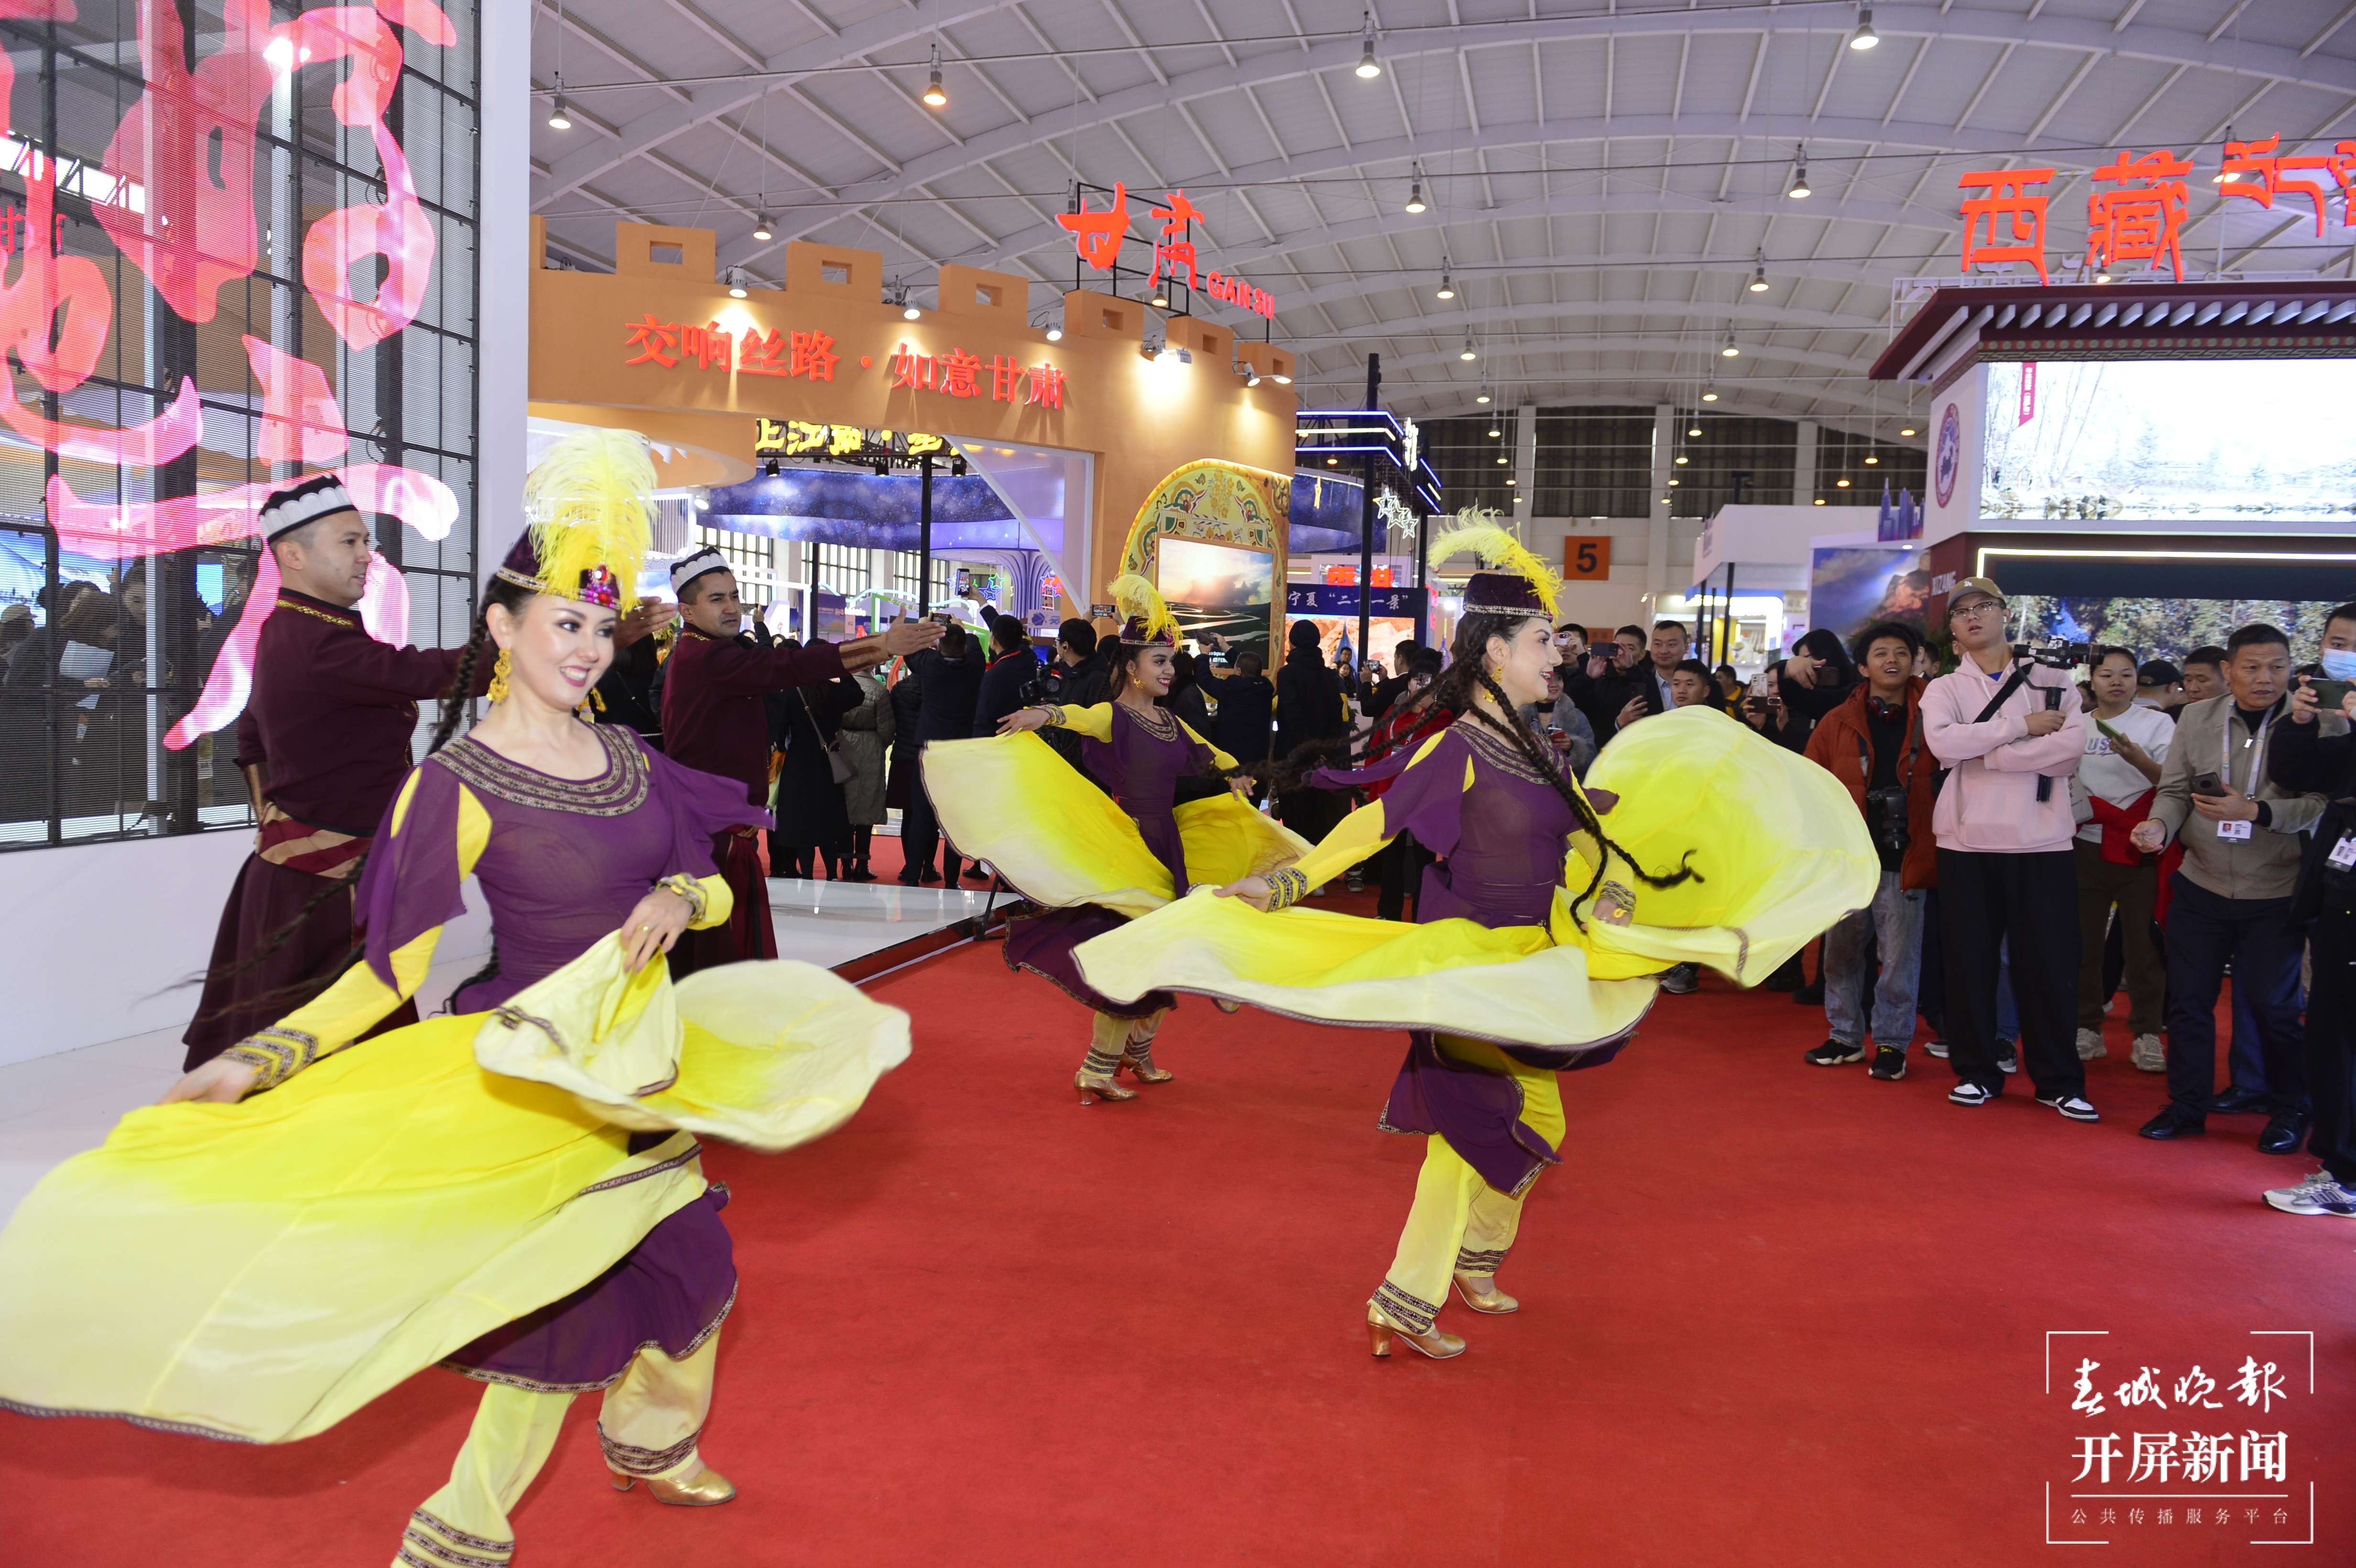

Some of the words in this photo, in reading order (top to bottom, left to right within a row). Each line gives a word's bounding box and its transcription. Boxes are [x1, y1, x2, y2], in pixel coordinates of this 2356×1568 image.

[1055, 182, 1204, 291] 甘肃
[1958, 149, 2194, 286] 西藏
[1206, 271, 1251, 310] GAN
[1254, 290, 1275, 319] SU
[1576, 543, 1597, 573] 5
[1288, 591, 1318, 607] 宁夏
